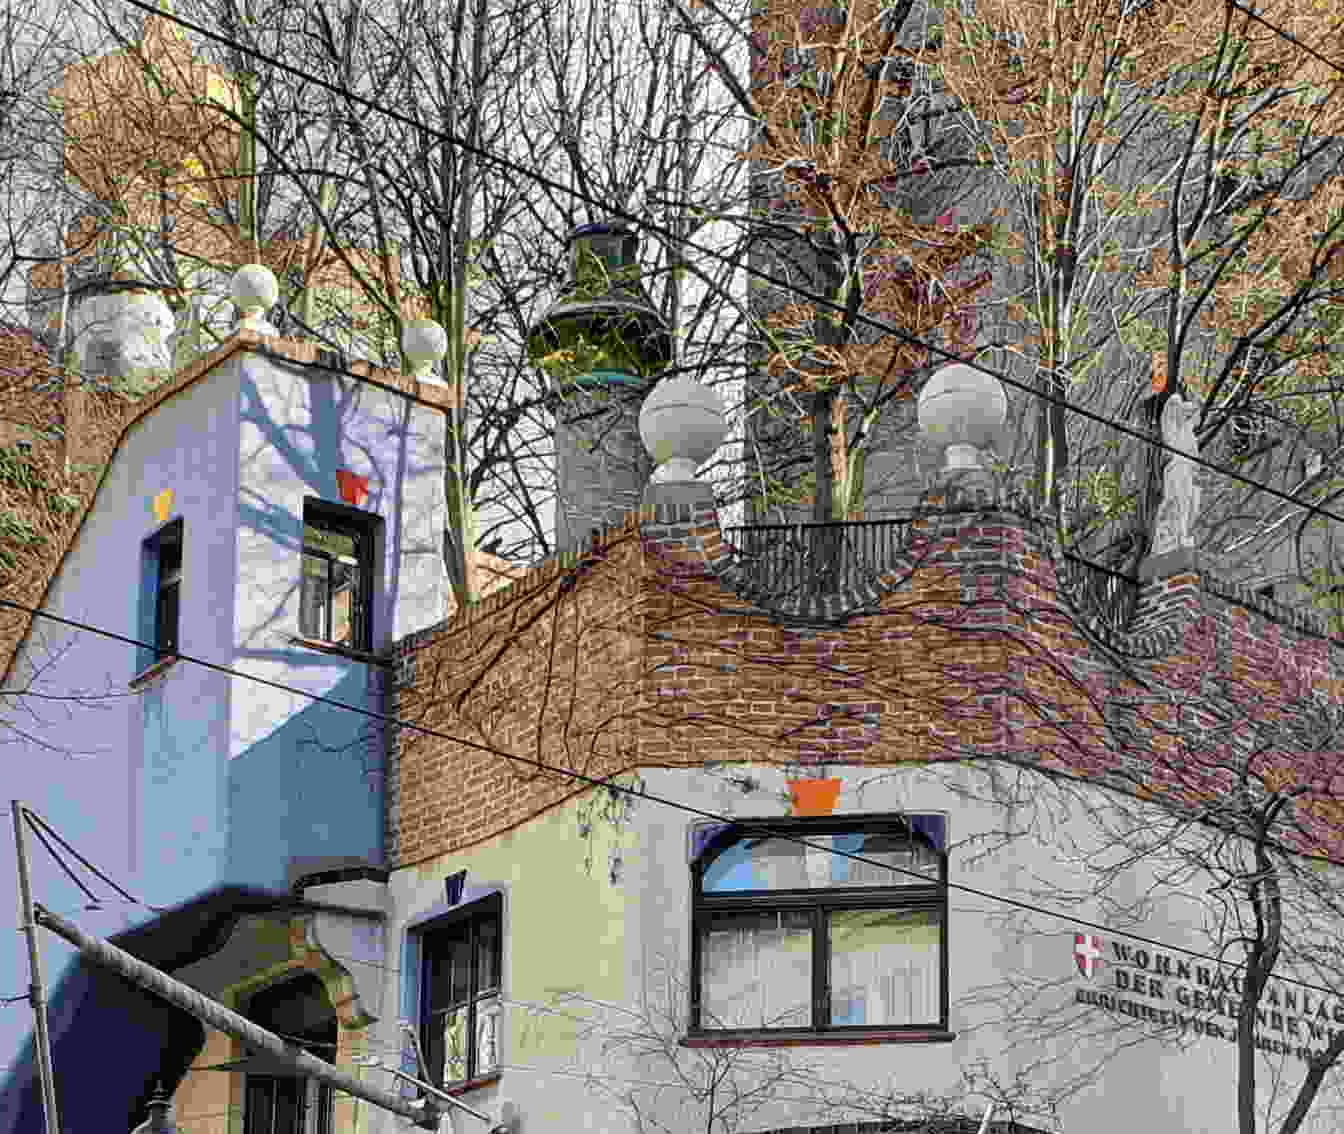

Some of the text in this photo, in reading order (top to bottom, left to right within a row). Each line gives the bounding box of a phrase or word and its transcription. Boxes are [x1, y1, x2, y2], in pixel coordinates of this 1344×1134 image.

[1115, 968, 1165, 999] DER
[1176, 985, 1300, 1034] GEMENDE
[1231, 1027, 1292, 1055] JHREN
